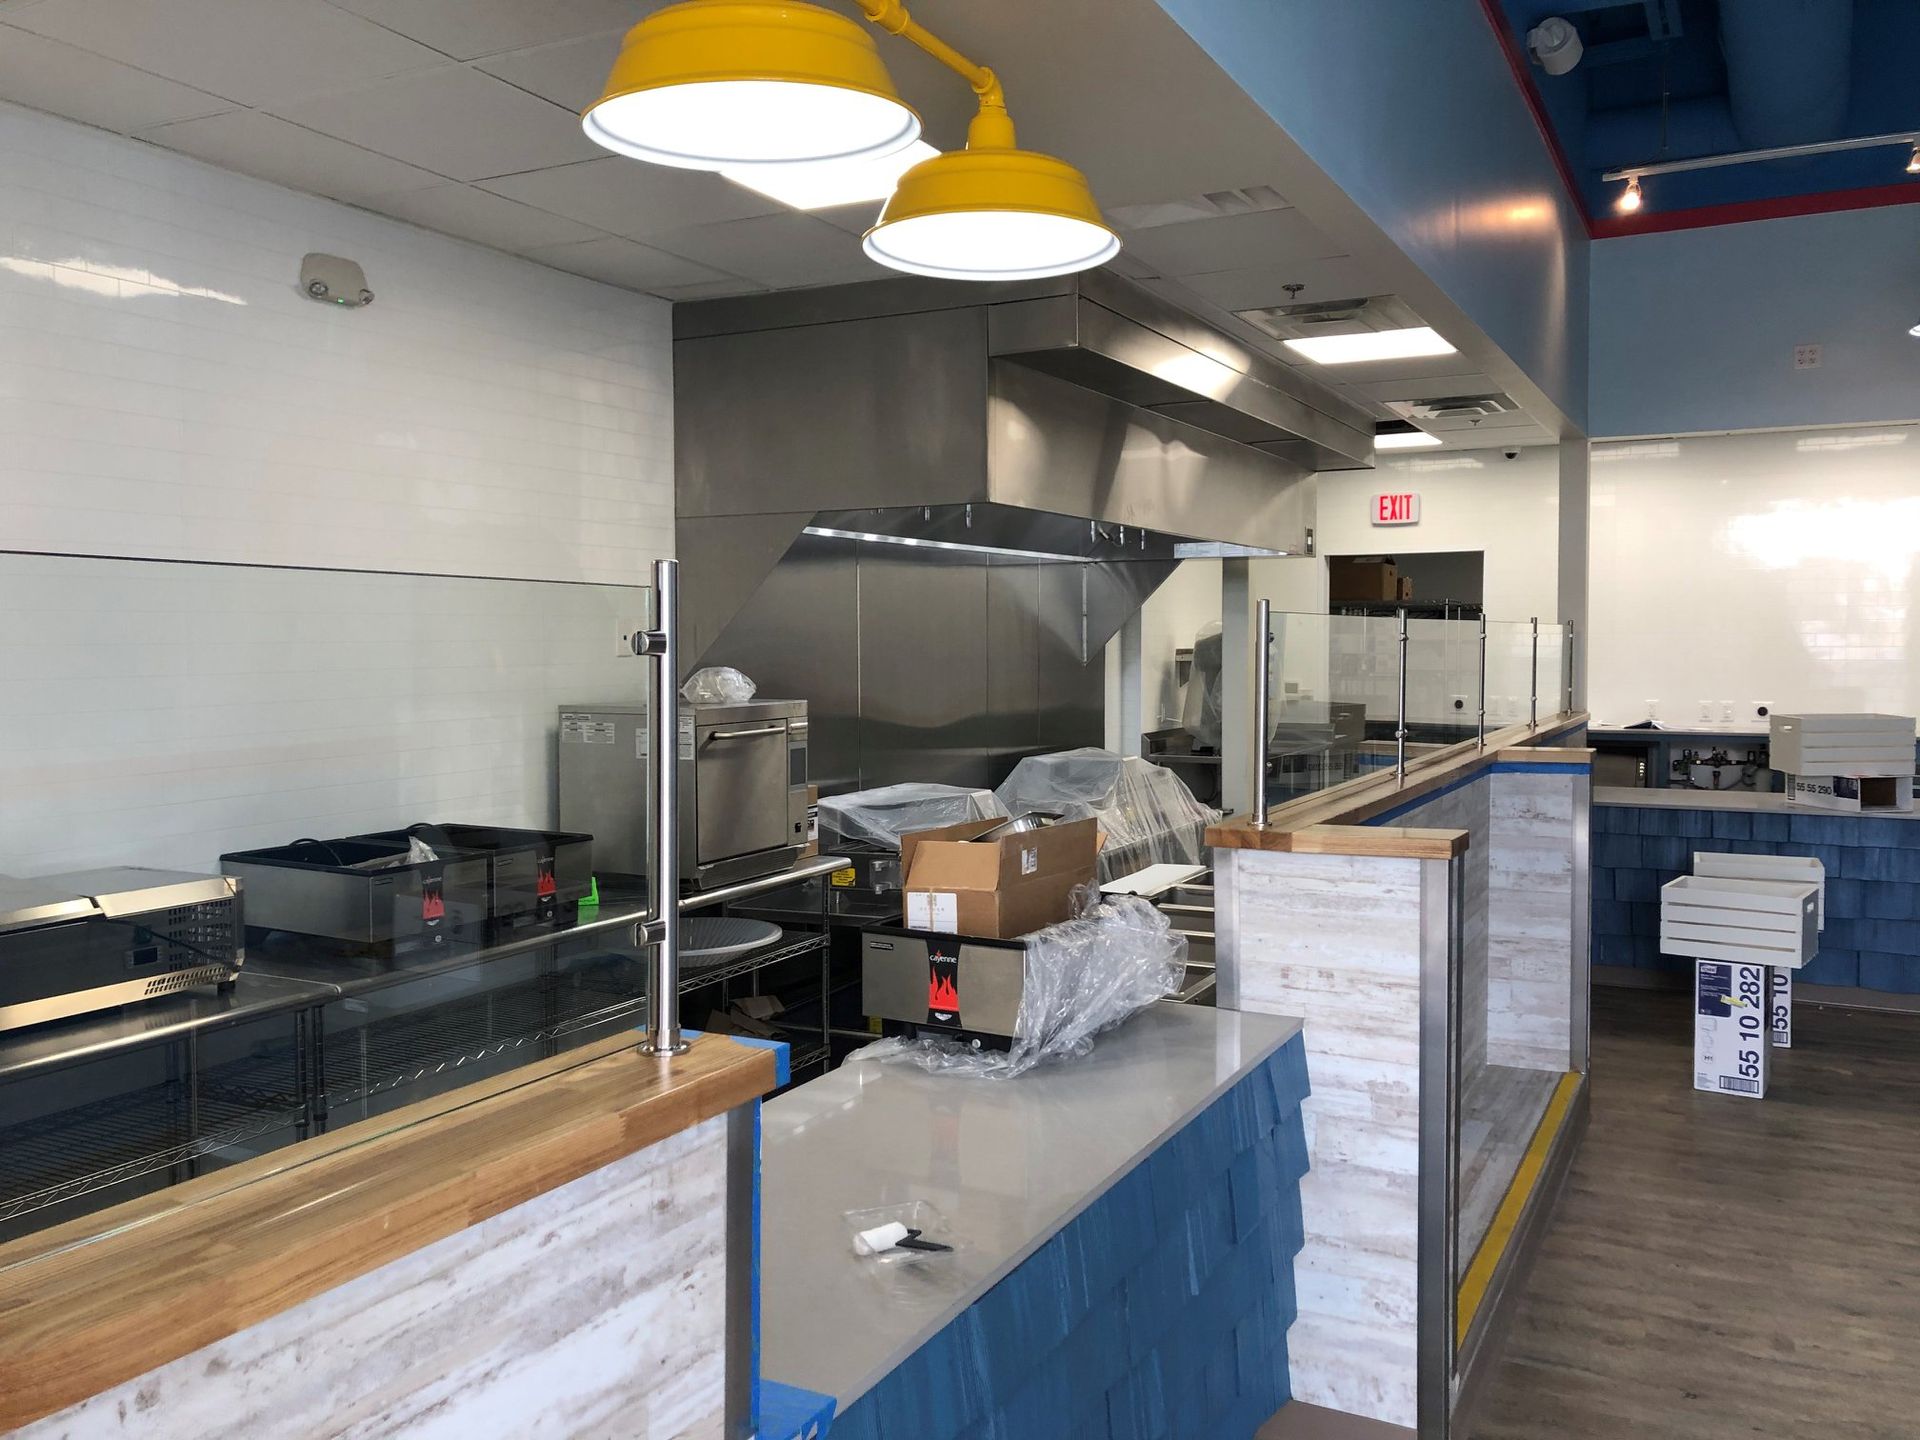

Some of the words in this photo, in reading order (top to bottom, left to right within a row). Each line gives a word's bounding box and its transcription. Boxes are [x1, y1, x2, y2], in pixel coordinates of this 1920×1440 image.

[1379, 495, 1413, 521] EXIT
[1796, 782, 1805, 792] 55
[1807, 784, 1816, 793] 55
[1740, 967, 1760, 1009] 282
[1773, 974, 1789, 997] 10
[1739, 1015, 1760, 1041] 10
[1772, 1005, 1788, 1030] 55
[1739, 1050, 1760, 1078] 55
